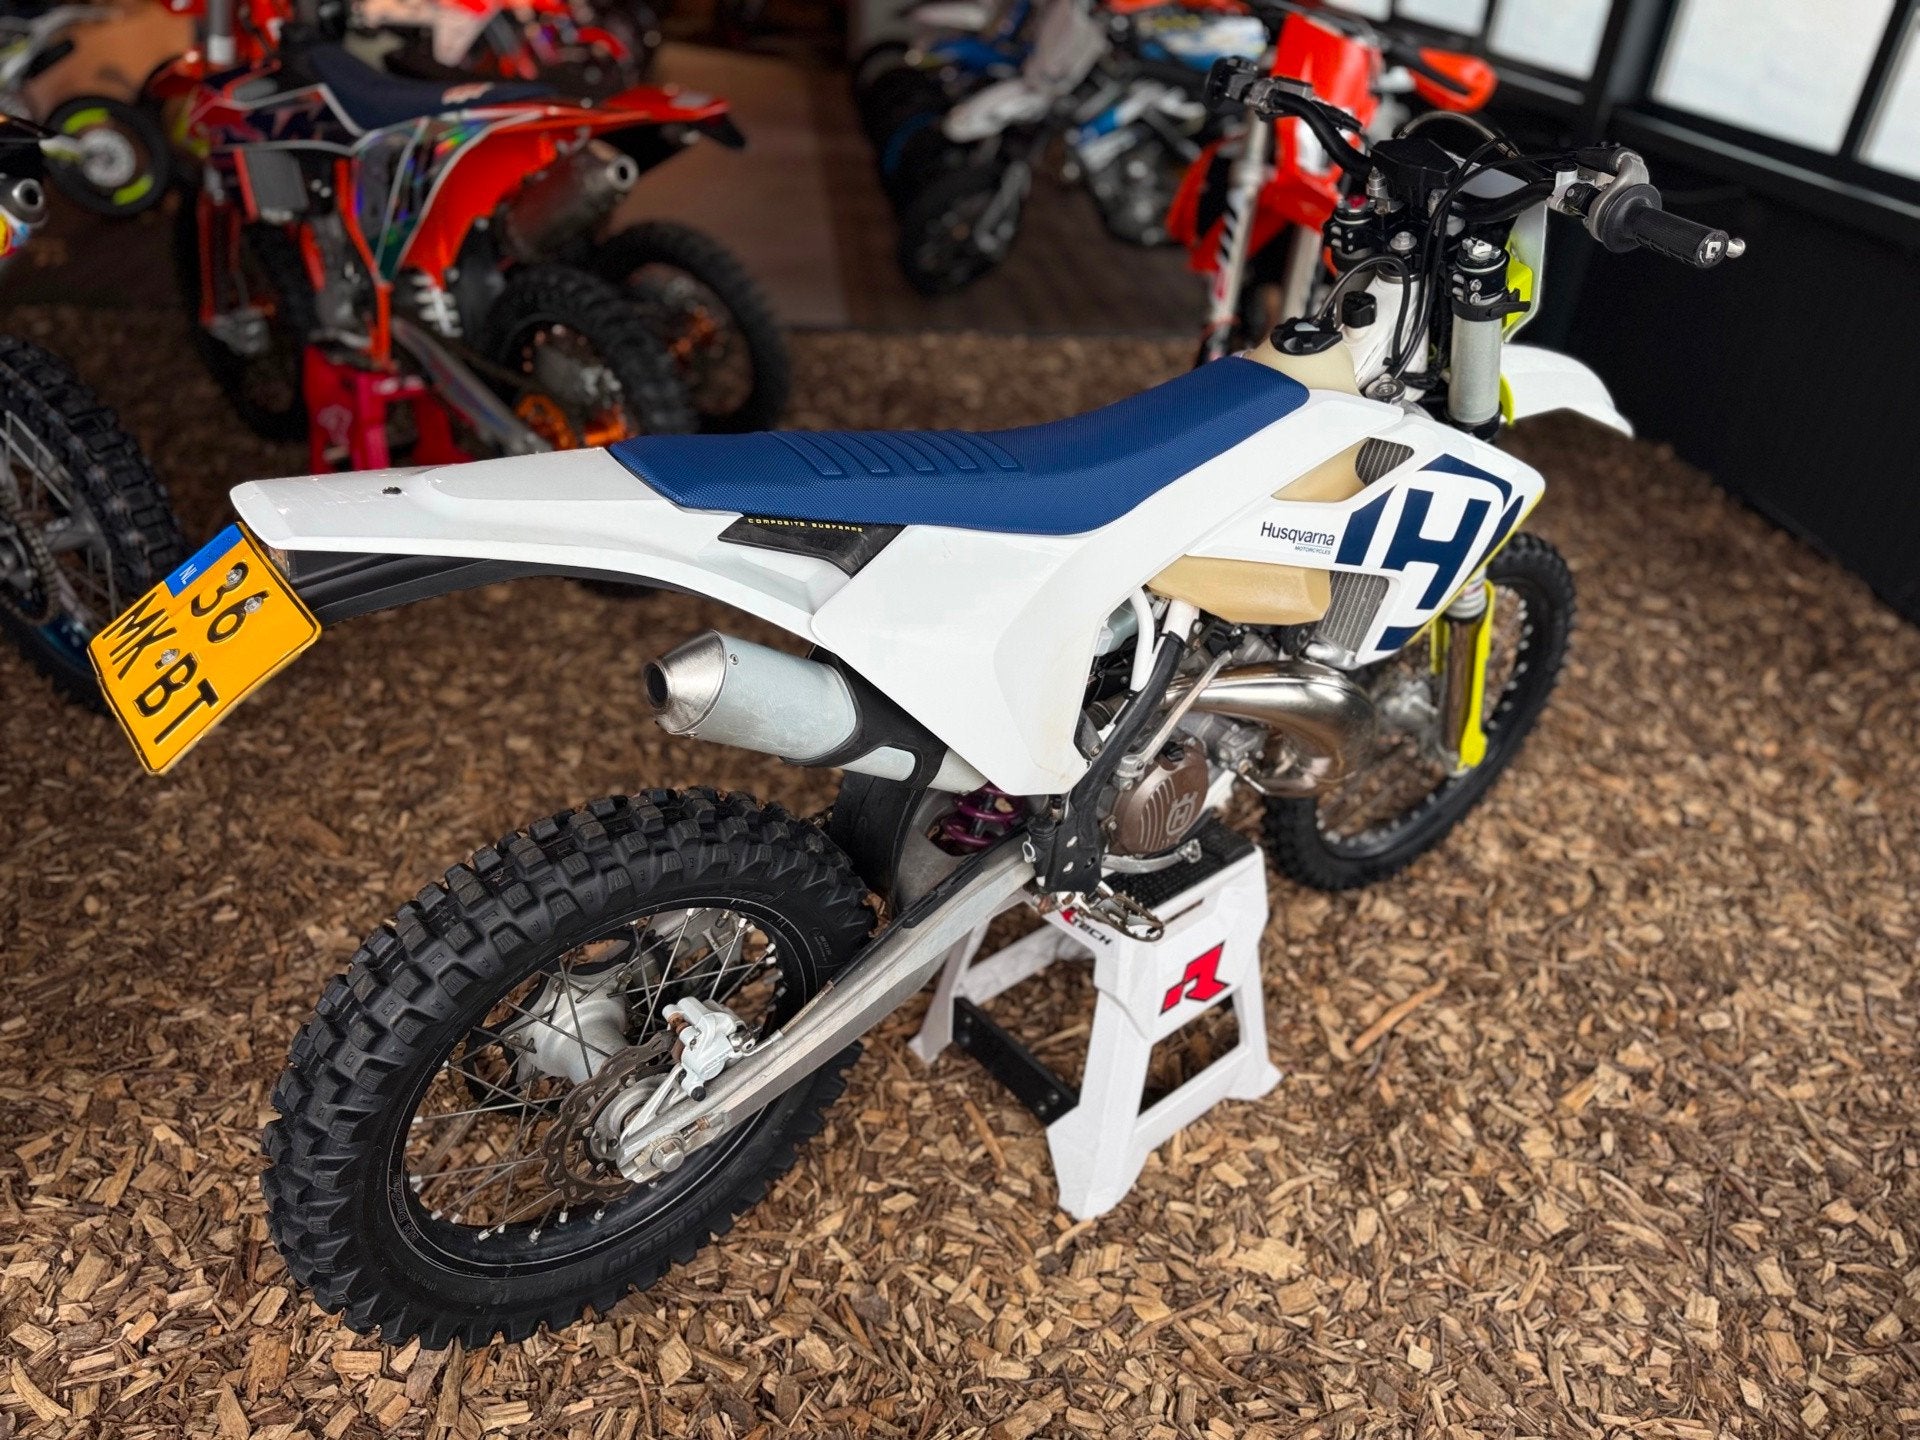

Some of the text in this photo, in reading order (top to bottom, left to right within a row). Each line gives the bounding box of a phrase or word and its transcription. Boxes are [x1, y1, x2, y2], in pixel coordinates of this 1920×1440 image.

[1260, 521, 1336, 546] Husqvarna
[1294, 545, 1332, 556] MOTORCYCLES
[178, 563, 198, 585] NL
[191, 561, 270, 643] 36
